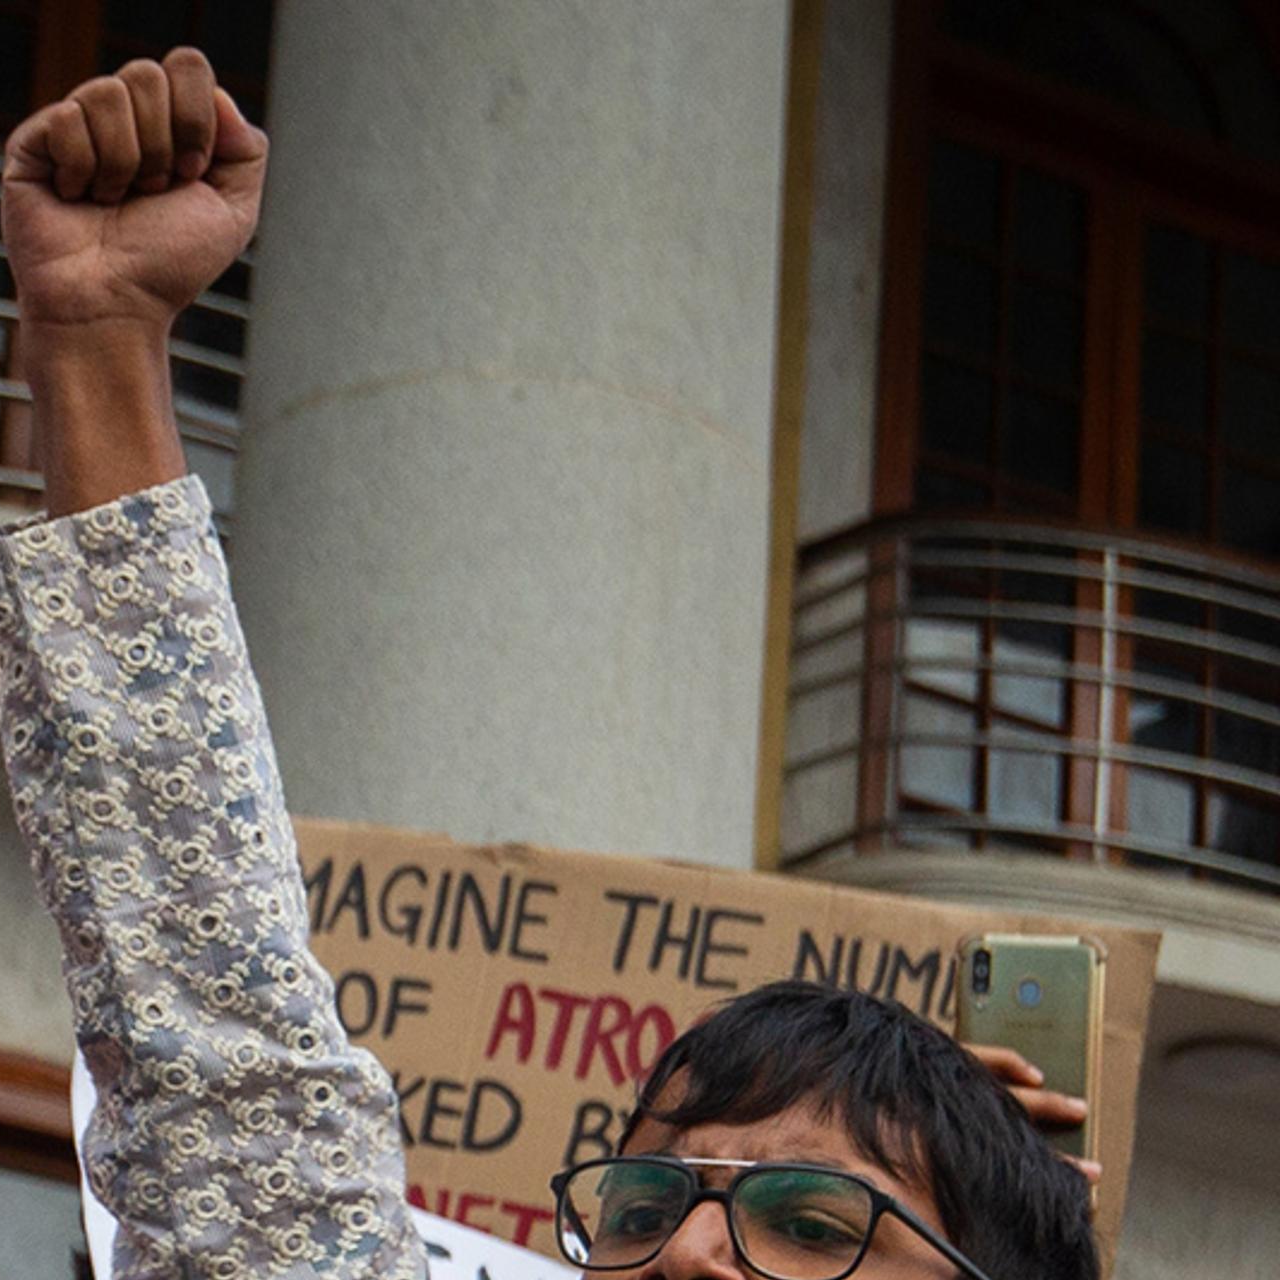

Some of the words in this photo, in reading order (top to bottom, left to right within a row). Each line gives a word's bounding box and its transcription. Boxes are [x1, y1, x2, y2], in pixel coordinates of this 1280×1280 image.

[605, 890, 766, 991] THE
[338, 970, 433, 1040] OF
[485, 980, 716, 1088] ATRO
[560, 1099, 632, 1168] B
